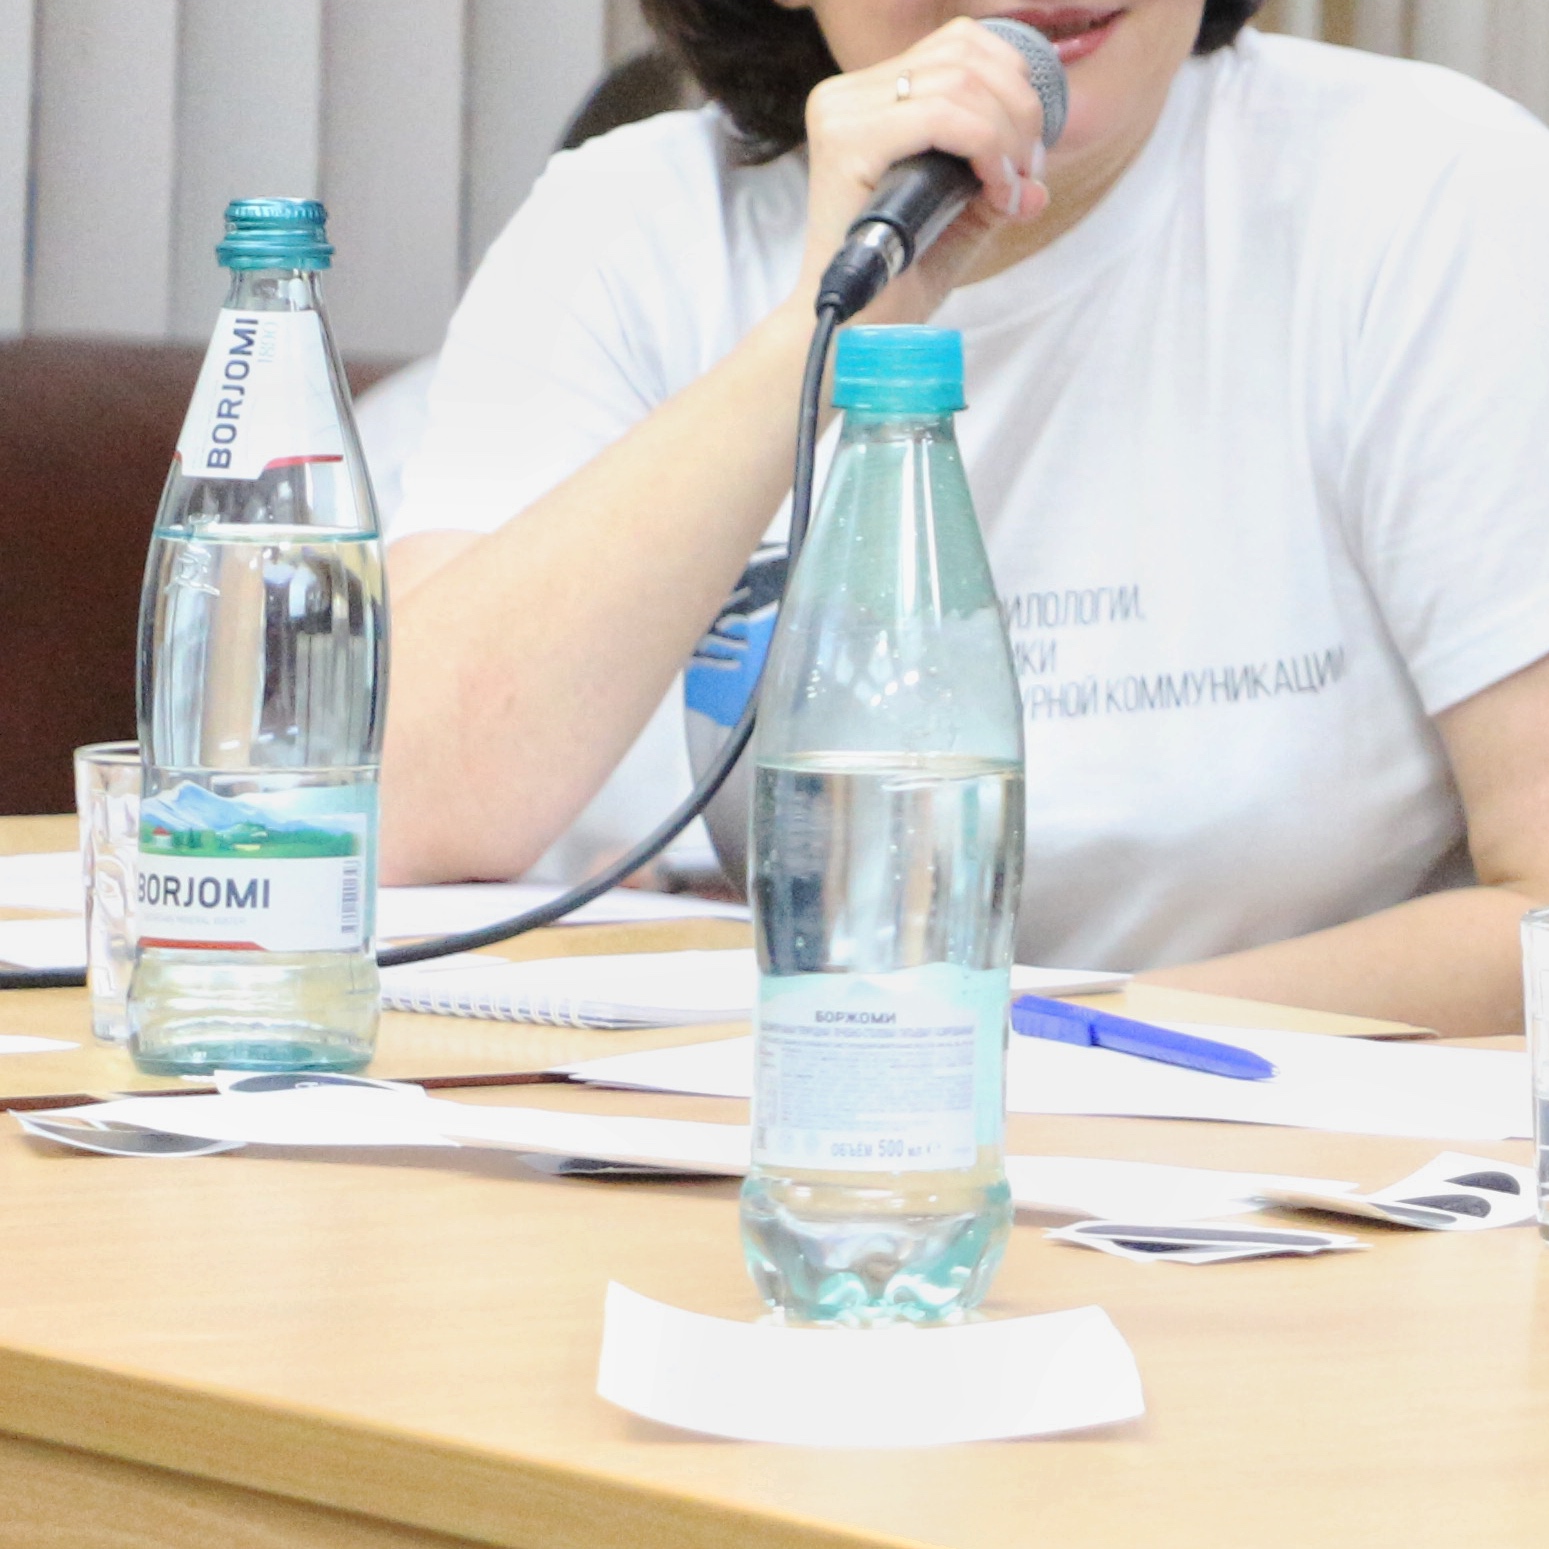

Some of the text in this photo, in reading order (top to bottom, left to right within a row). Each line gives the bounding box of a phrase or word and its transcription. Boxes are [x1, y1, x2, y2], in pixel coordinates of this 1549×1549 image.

[206, 318, 259, 469] BORJOMI
[1002, 584, 1146, 628] ИЛОЛОГИИ,
[1015, 638, 1056, 674] КИ
[1106, 641, 1347, 713] КОММУНИКАЦИИ
[138, 872, 270, 909] BORJOMI
[815, 1010, 897, 1024] БОРЖОМИ
[878, 1138, 904, 1158] 500
